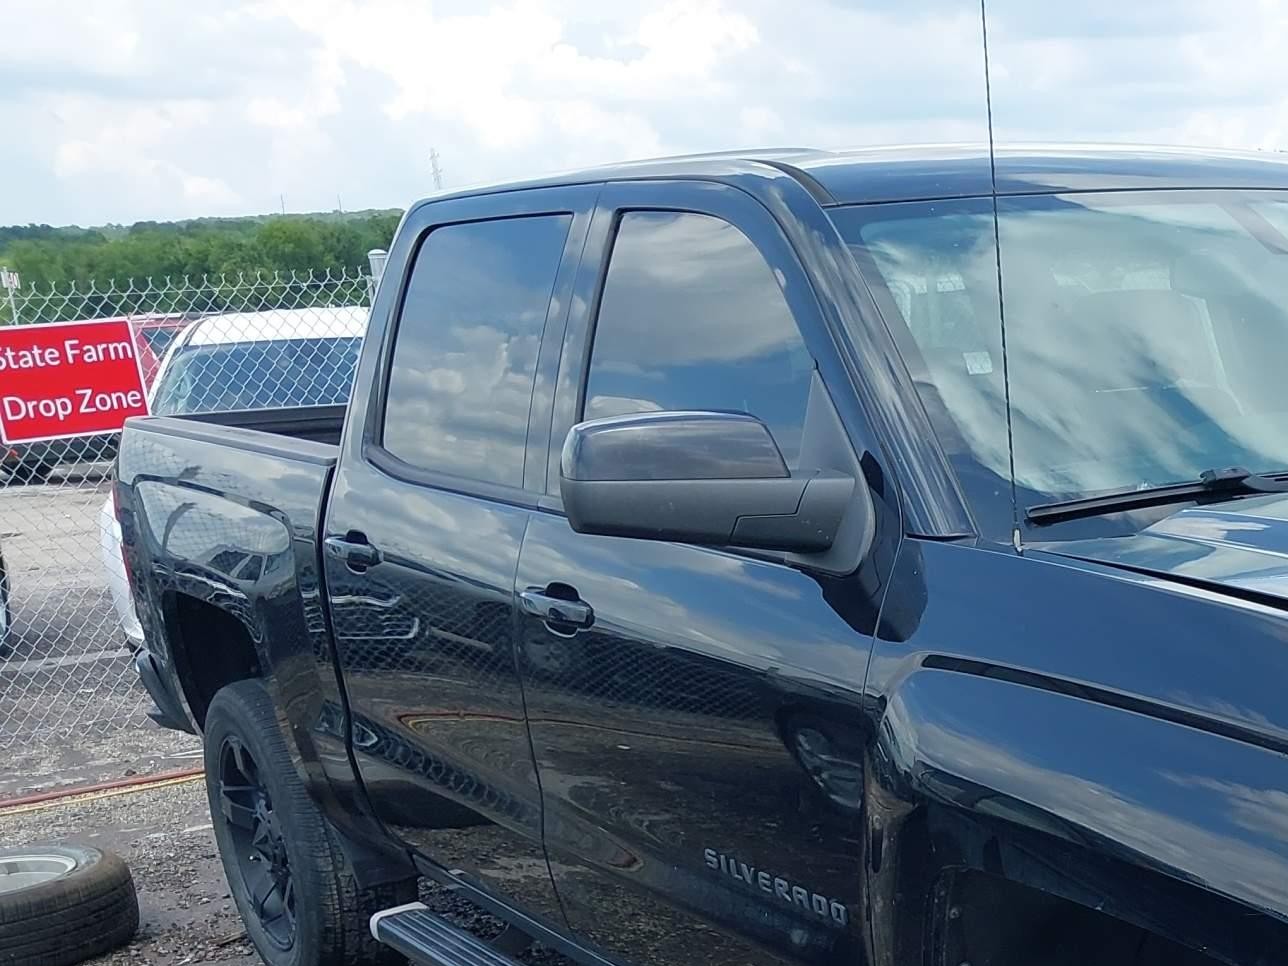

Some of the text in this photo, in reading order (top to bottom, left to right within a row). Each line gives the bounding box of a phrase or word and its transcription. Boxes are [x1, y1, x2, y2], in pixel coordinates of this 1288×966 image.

[64, 339, 133, 364] Farm
[2, 388, 142, 421] Drop Zone
[704, 848, 849, 926] SILVERADO
